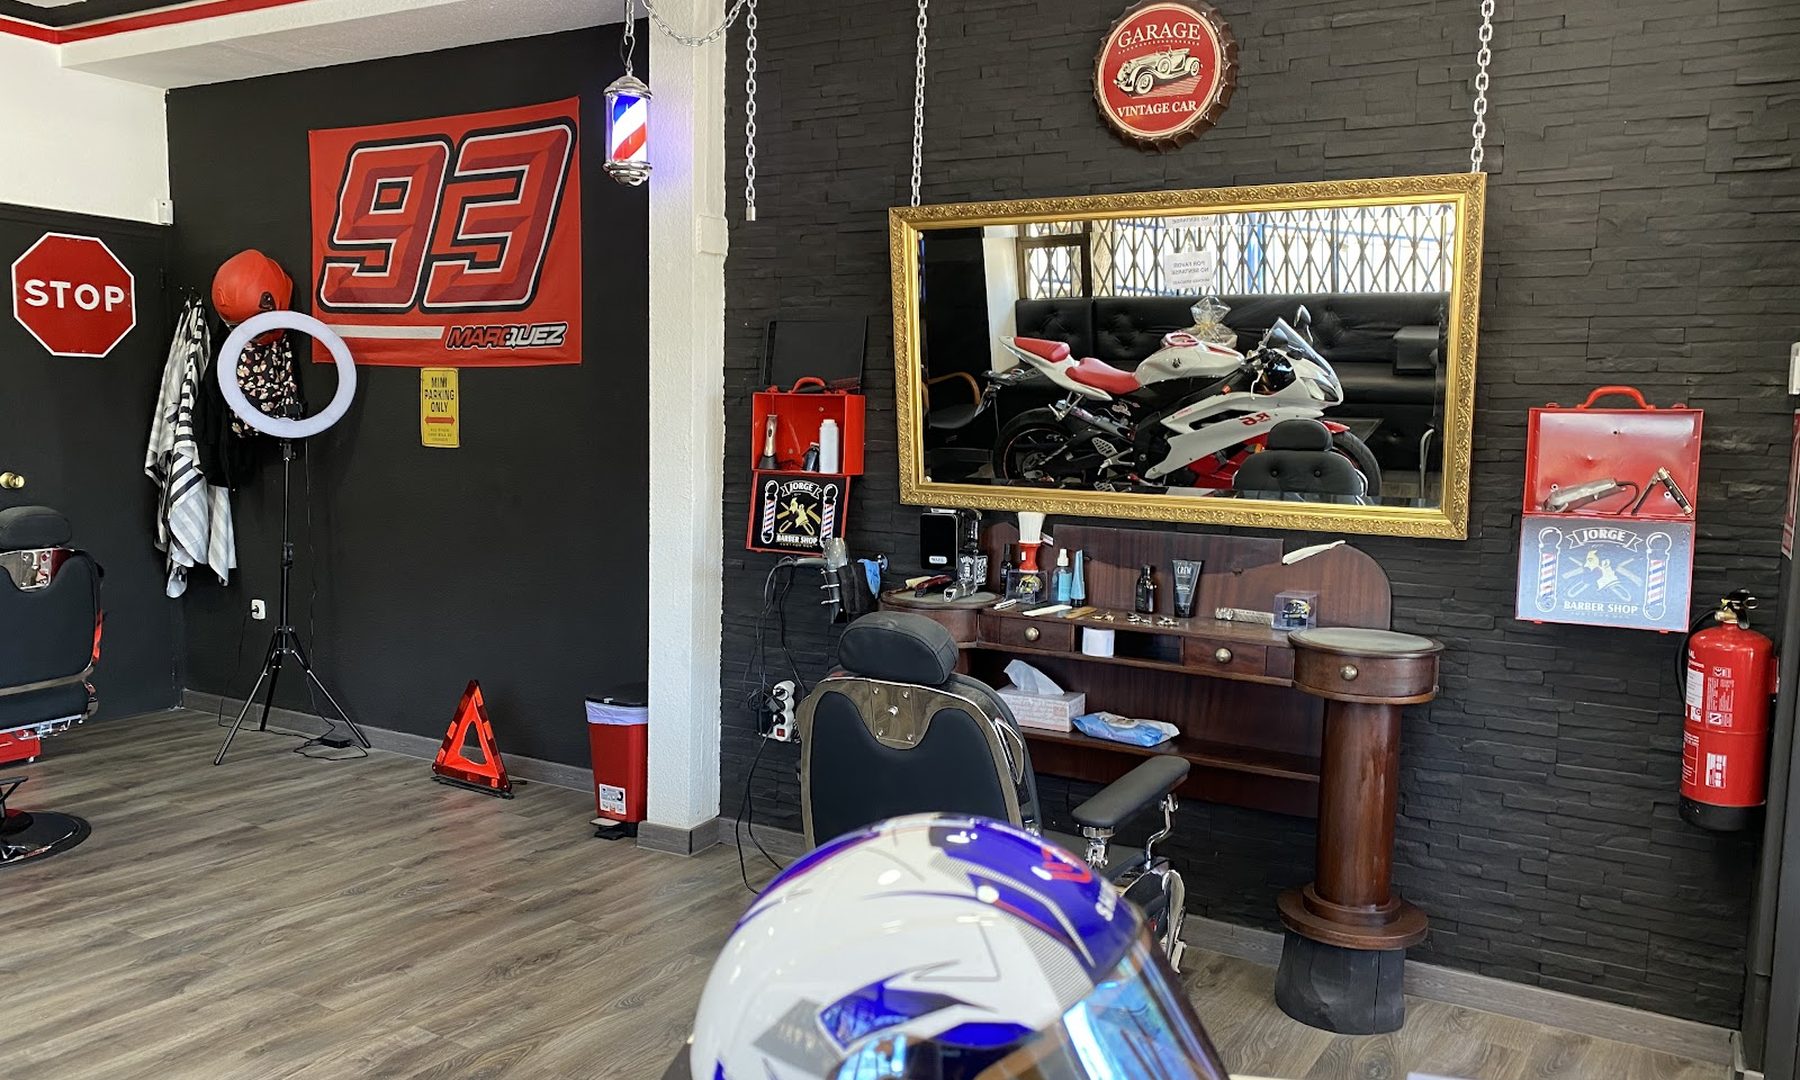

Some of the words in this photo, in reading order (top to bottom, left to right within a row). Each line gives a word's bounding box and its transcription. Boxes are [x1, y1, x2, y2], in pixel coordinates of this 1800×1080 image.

[1117, 22, 1201, 48] GARAGE
[1117, 102, 1170, 118] VINTAGE
[1172, 100, 1197, 112] CAR
[315, 115, 578, 315] 93
[23, 279, 125, 312] STOP
[446, 322, 567, 350] MARQUEZ
[431, 377, 448, 388] MINI
[424, 389, 455, 401] PARKING
[430, 401, 449, 413] ONLY
[788, 482, 814, 493] JORGE
[776, 534, 800, 543] BARBER
[801, 535, 818, 545] SHOP
[1583, 529, 1626, 542] JORGE
[1563, 600, 1604, 612] BARBER
[1607, 603, 1639, 615] SHOP
